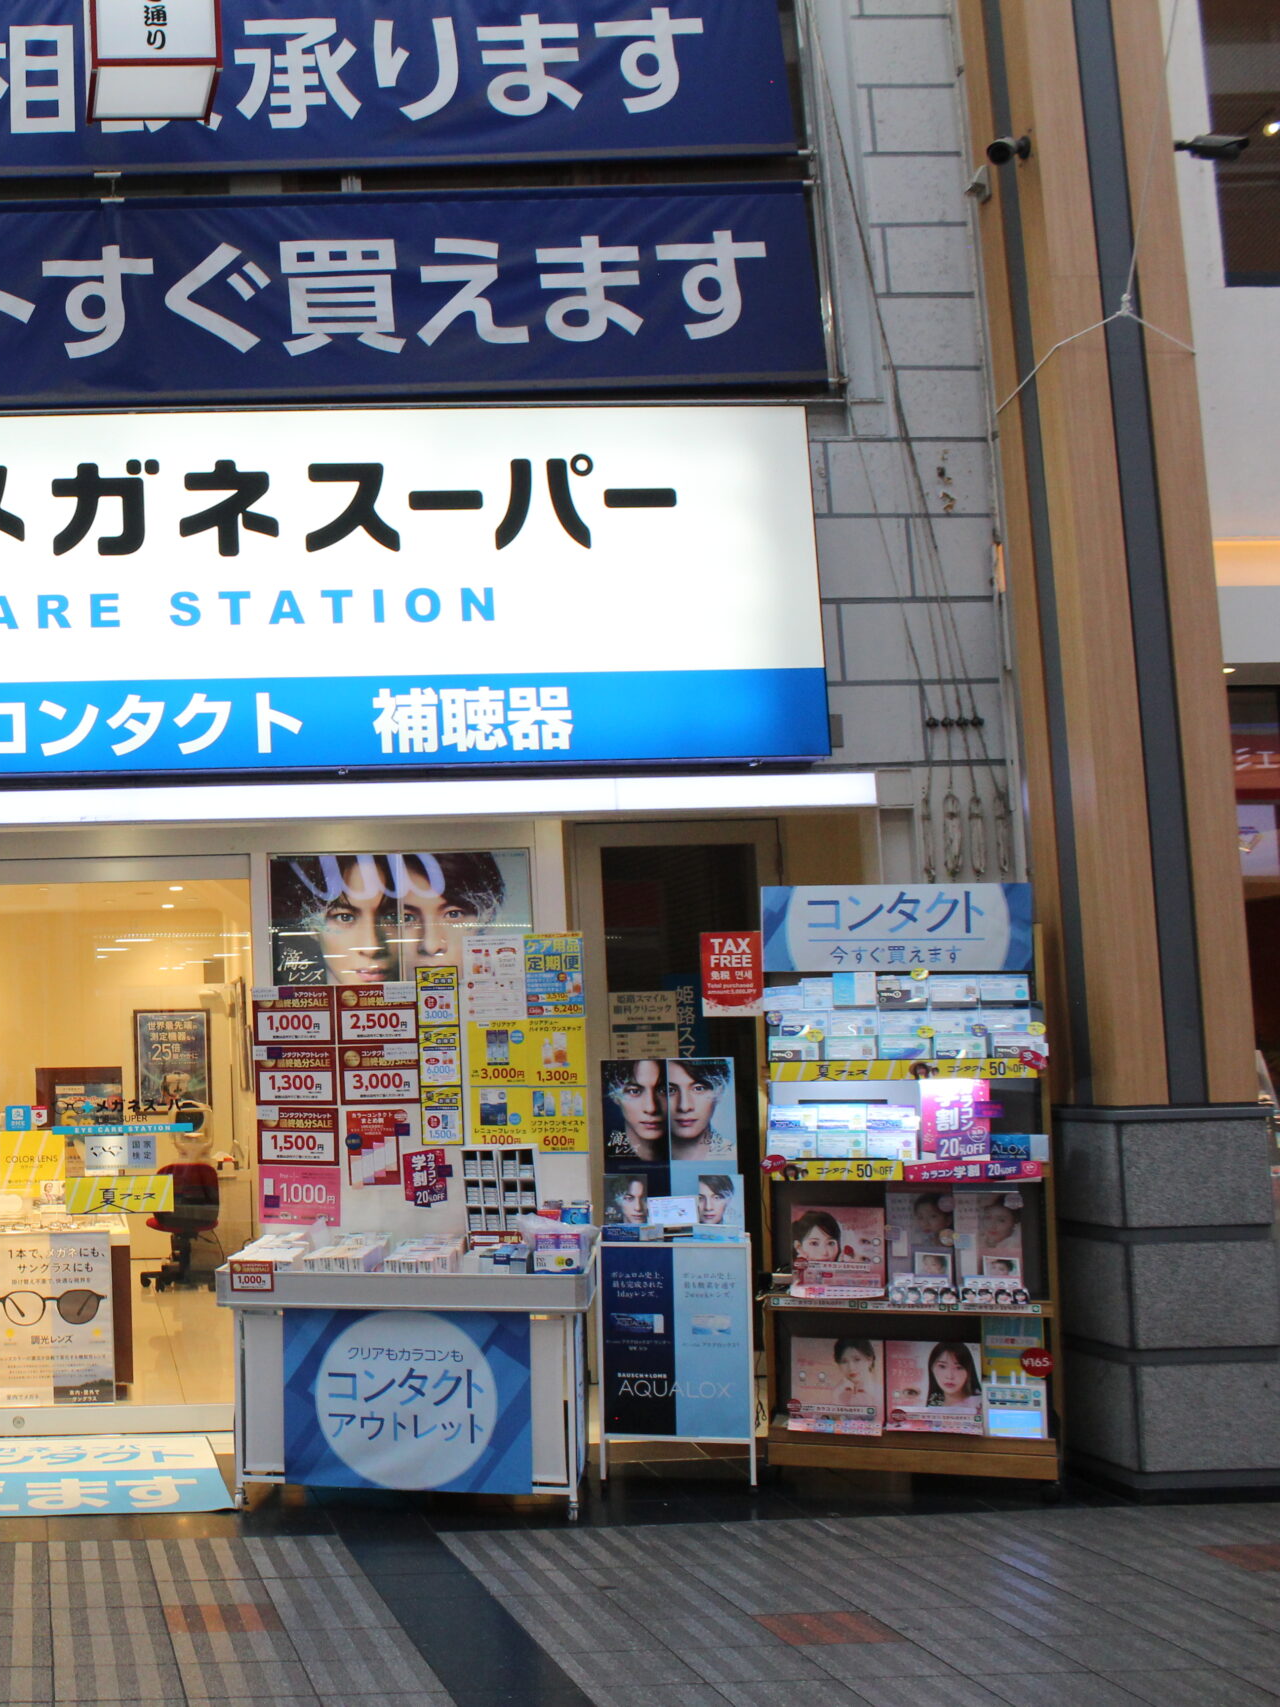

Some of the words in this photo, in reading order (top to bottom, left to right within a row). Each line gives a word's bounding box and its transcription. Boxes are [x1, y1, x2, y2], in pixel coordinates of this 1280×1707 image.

[144, 0, 168, 50] 通り
[169, 587, 496, 627] STATION
[372, 685, 573, 755] 補聴器
[807, 890, 985, 934] コンタクト
[526, 939, 580, 953] ケア用品
[710, 937, 751, 954] TAX
[526, 954, 582, 971] 定期便
[710, 954, 752, 968] FREE
[830, 945, 962, 965] 今すぐ買えます
[288, 968, 324, 983] レンズ
[266, 1014, 320, 1033] 1,000円
[350, 1012, 408, 1031] 2,500円
[480, 1068, 525, 1079] 3,000円
[536, 1071, 578, 1082] 1,300円
[816, 1064, 870, 1081] 夏フェス
[947, 1065, 987, 1074] コンタクト
[268, 1074, 322, 1092] 1,300円
[352, 1073, 411, 1090] 3,000円
[95, 1098, 194, 1113] メガネスーパー
[74, 1126, 93, 1134] EYE
[128, 1124, 171, 1133] STATION
[270, 1134, 325, 1152] 1,500円
[543, 1135, 575, 1146] 600円
[5, 1154, 35, 1165] COLOR
[36, 1153, 58, 1163] LENS
[426, 1152, 437, 1187] カラコン
[816, 1167, 854, 1175] コンタクト
[921, 1164, 980, 1180] カラコン学割
[92, 1187, 157, 1210] 夏フェス
[280, 1183, 336, 1205] 1,000円
[17, 1262, 94, 1274] サングラスにも
[30, 1335, 73, 1345] 調光レンズ
[347, 1347, 464, 1363] クリアもカラコンも
[328, 1367, 484, 1409] コンタクト
[618, 1379, 733, 1399] AQUALOX
[328, 1410, 484, 1444] アウトレット
